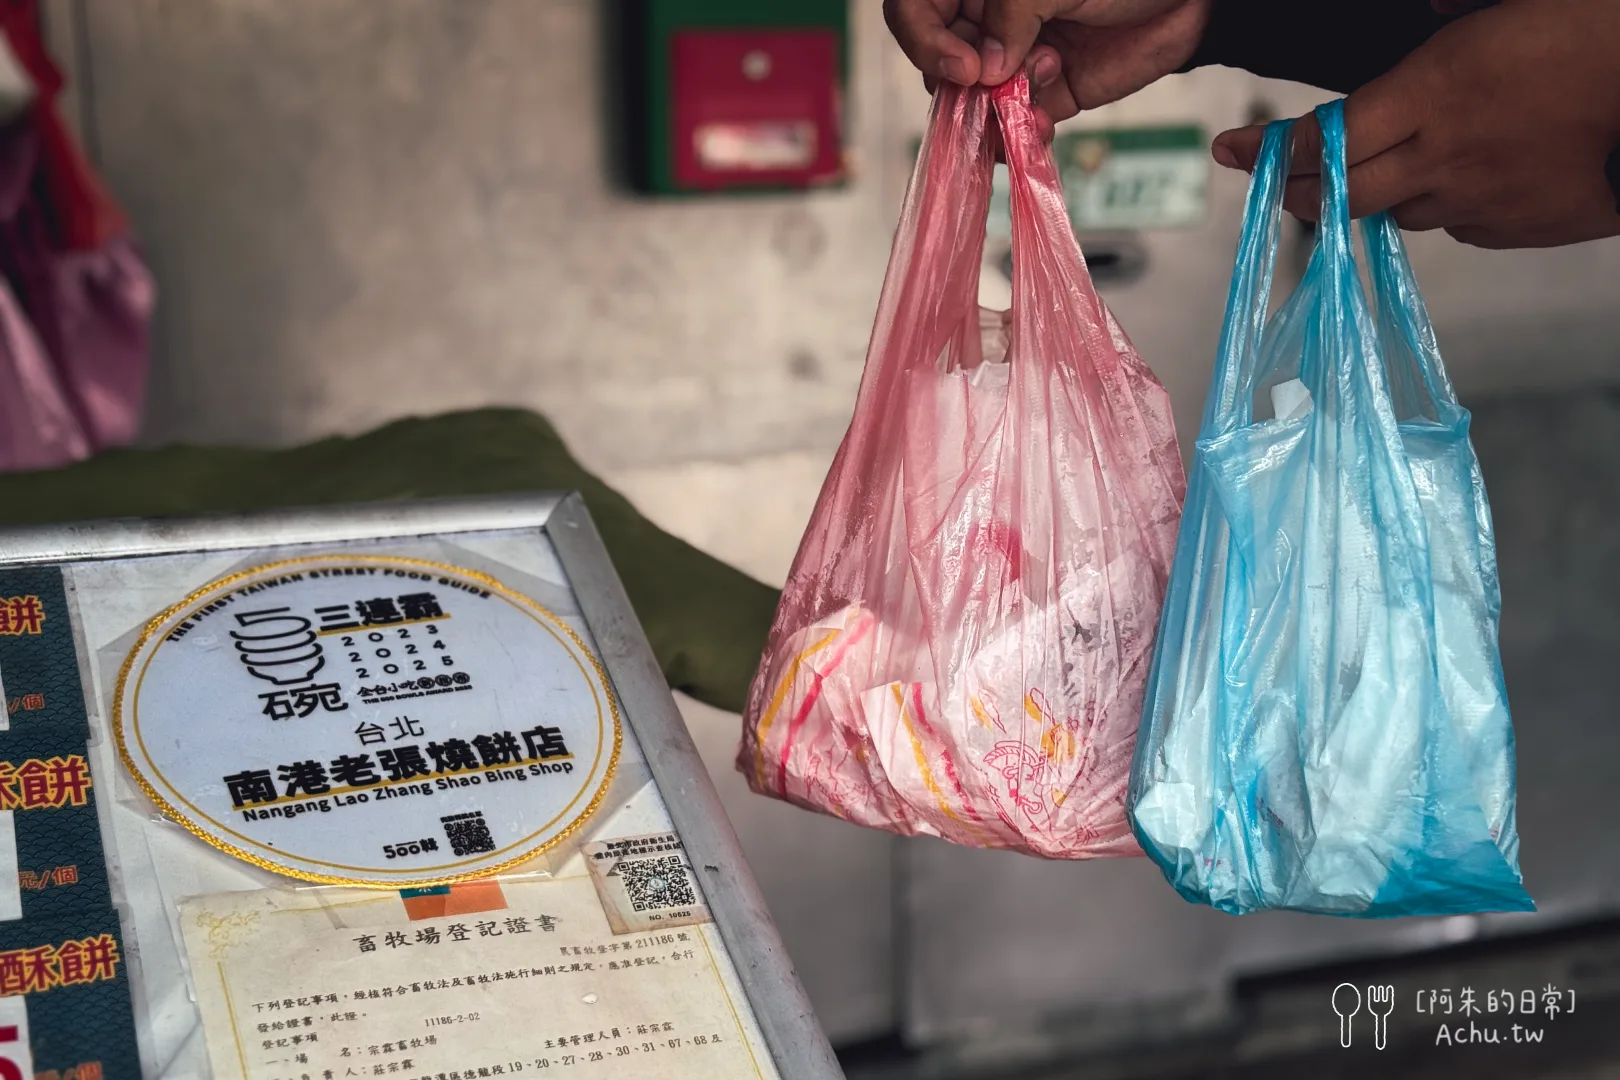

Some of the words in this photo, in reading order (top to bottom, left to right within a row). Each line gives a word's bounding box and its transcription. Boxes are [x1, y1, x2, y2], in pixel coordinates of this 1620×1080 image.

[165, 621, 195, 642] THE
[190, 594, 235, 622] FIRST
[236, 573, 304, 597] TAIWAN
[308, 567, 377, 579] STREET
[383, 567, 432, 582] FOOD
[437, 577, 492, 600] GUIDE
[355, 715, 425, 746] 台北
[223, 725, 569, 807] 南港老張燒餅店
[243, 798, 332, 822] Nangang
[334, 792, 369, 807] Lao
[373, 782, 433, 800] Zhang
[435, 774, 481, 790] Shao
[485, 768, 527, 784] Bing
[528, 761, 573, 777] Shop
[352, 914, 558, 953] 畜牧場登記證書
[424, 1011, 481, 1028] 11186-2-02
[262, 1031, 319, 1050] 登記事項
